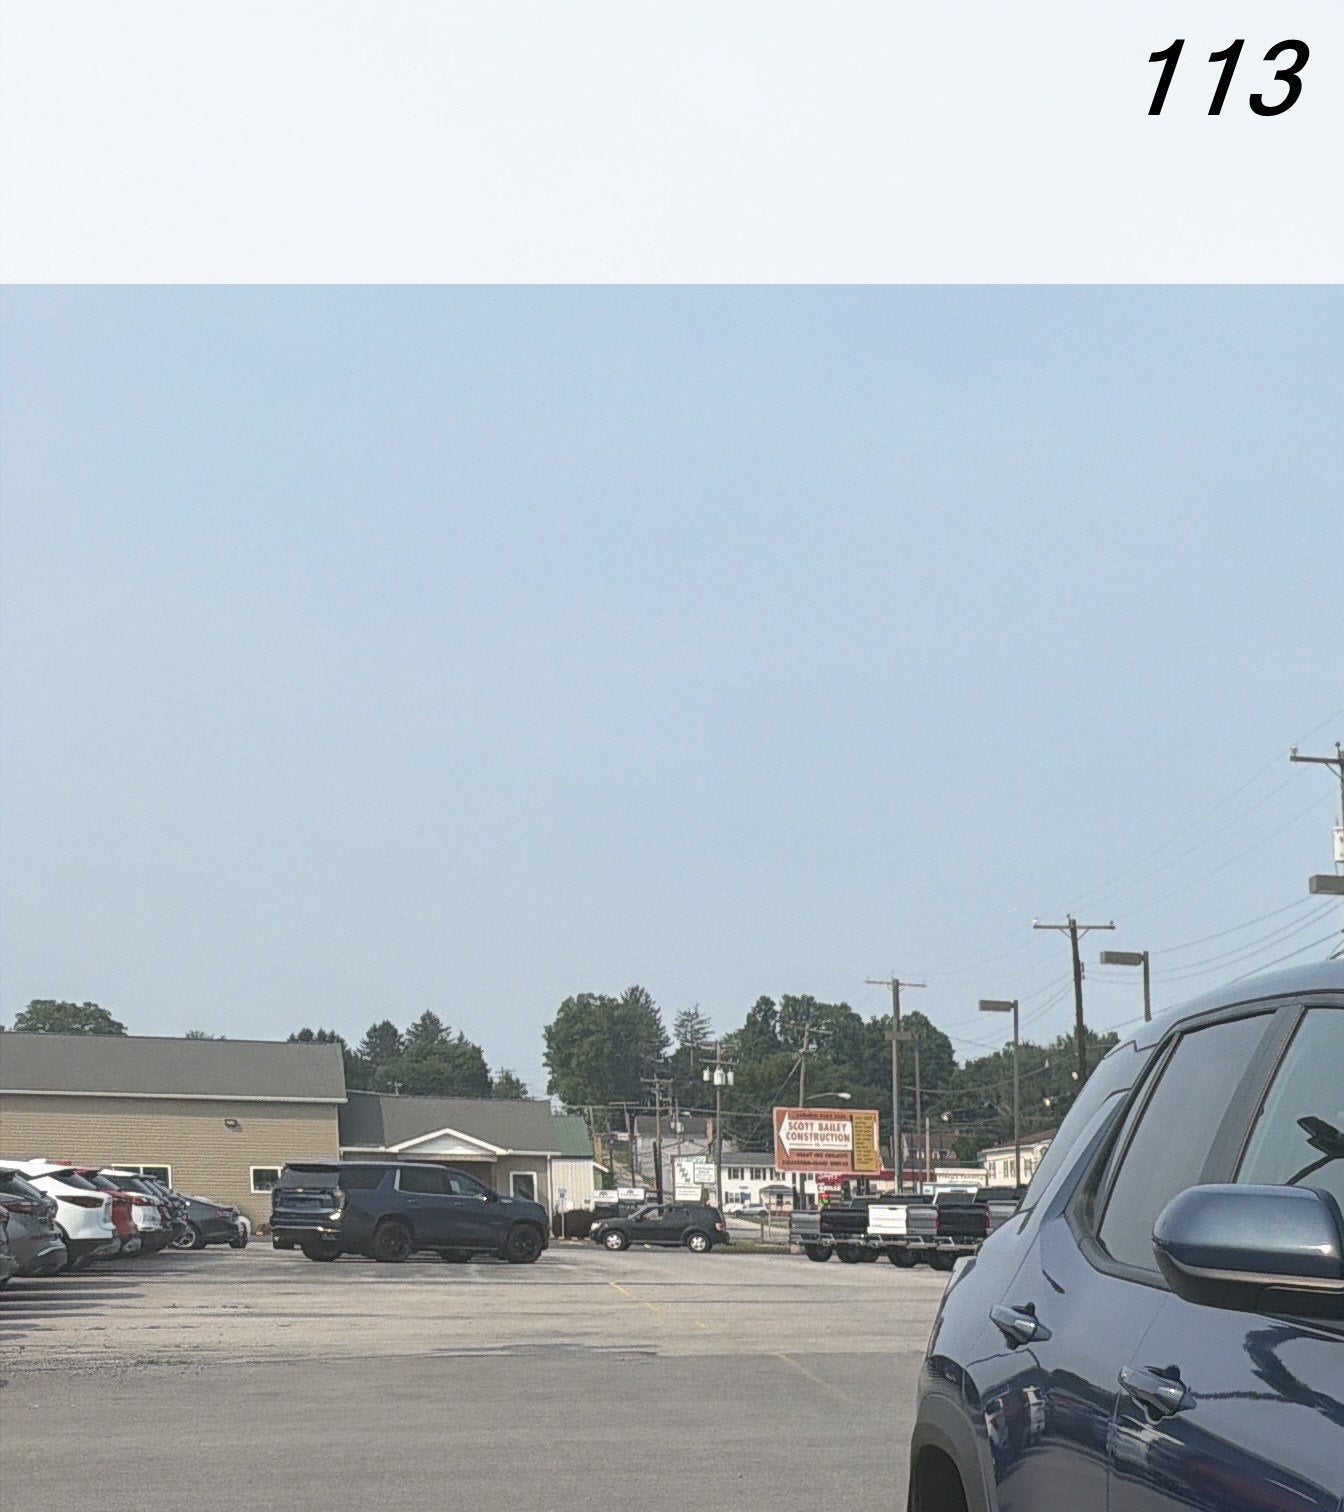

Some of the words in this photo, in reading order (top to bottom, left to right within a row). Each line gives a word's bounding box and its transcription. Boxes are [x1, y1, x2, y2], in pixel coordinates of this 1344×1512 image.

[787, 1121, 814, 1131] SCOTT
[818, 1122, 847, 1132] BAILEY
[786, 1132, 850, 1142] CONSTRUCTION
